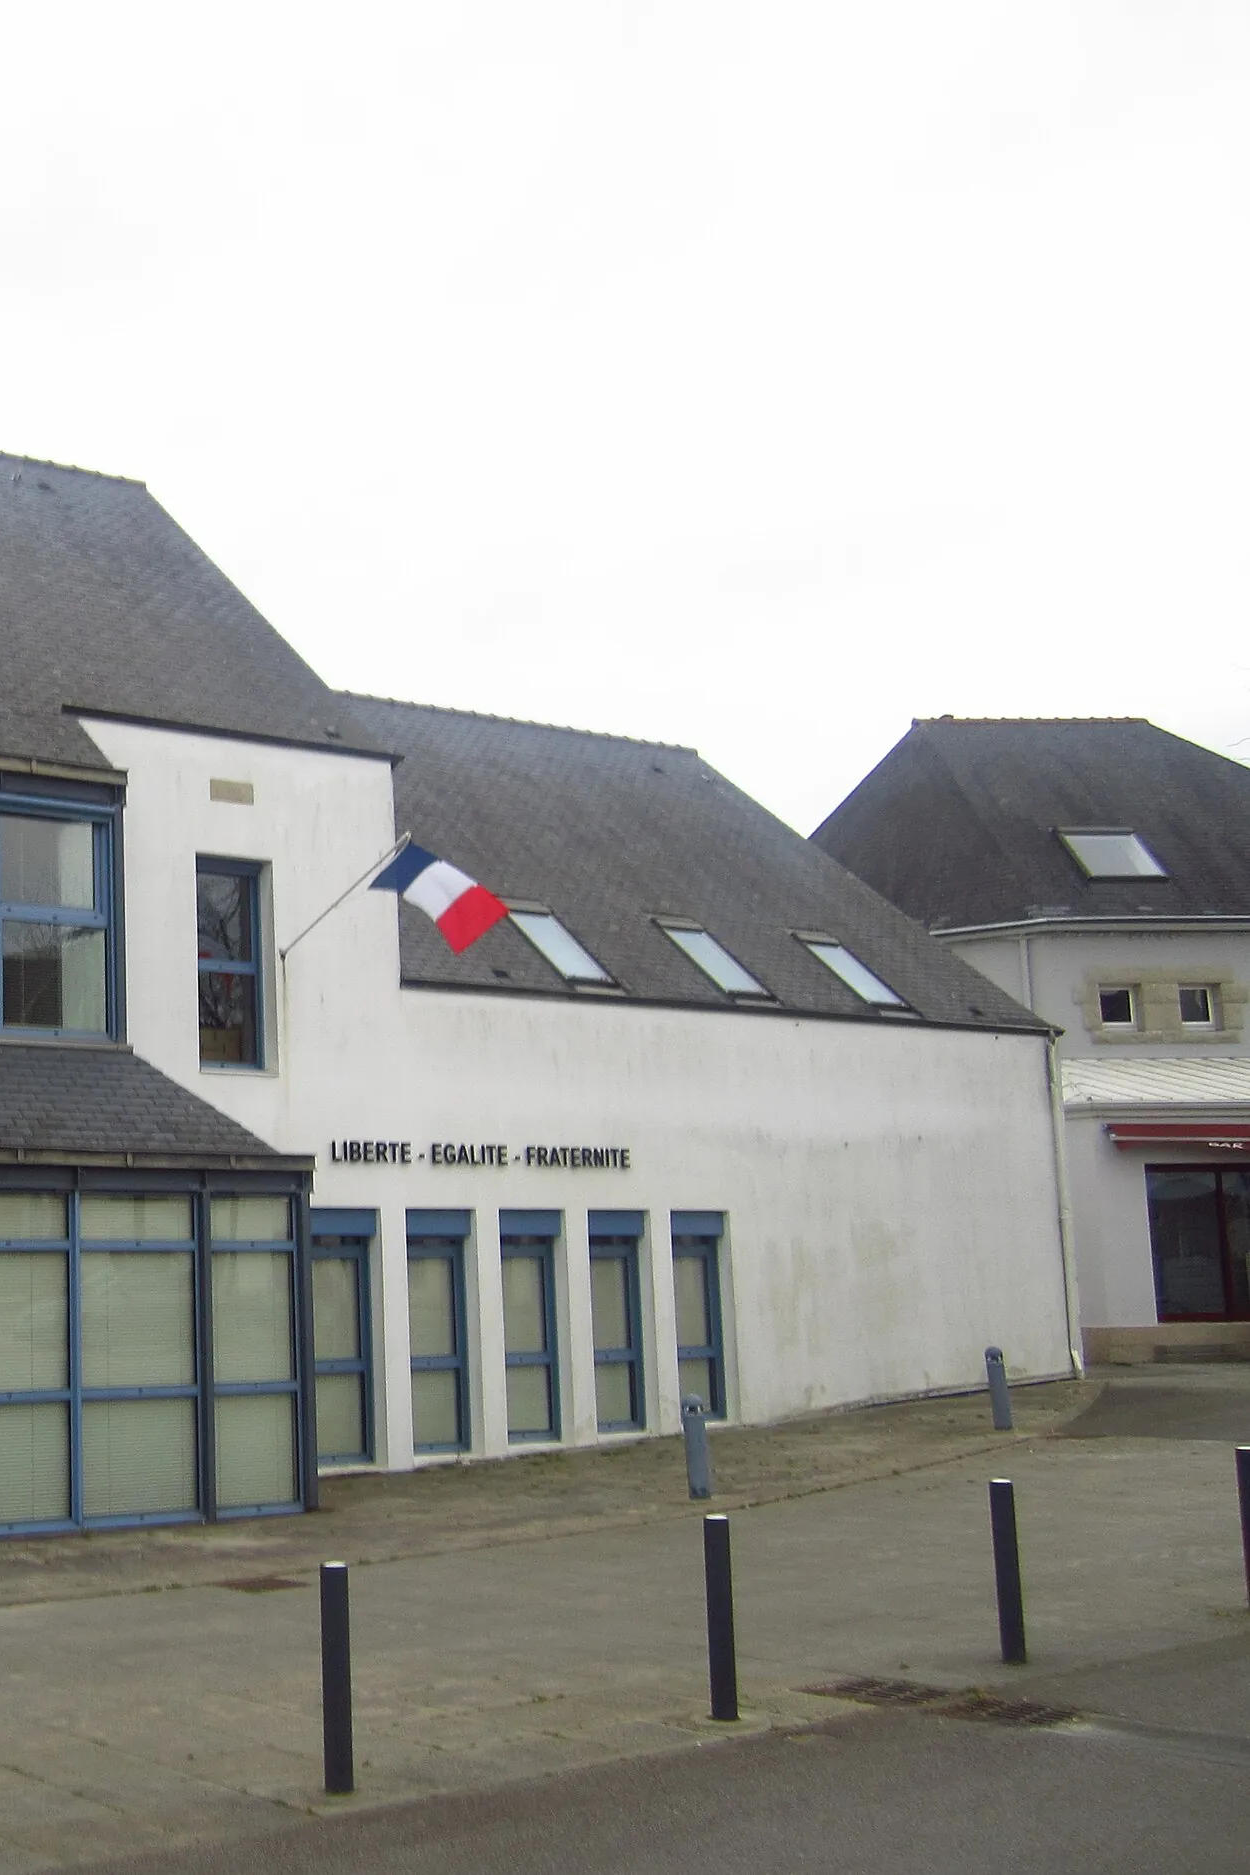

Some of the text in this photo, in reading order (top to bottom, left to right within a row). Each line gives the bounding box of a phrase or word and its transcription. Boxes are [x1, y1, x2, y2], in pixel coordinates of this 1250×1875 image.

[331, 1140, 412, 1164] LIBERTE
[431, 1143, 508, 1166] EGALITE
[526, 1145, 631, 1169] FRATERNITE
